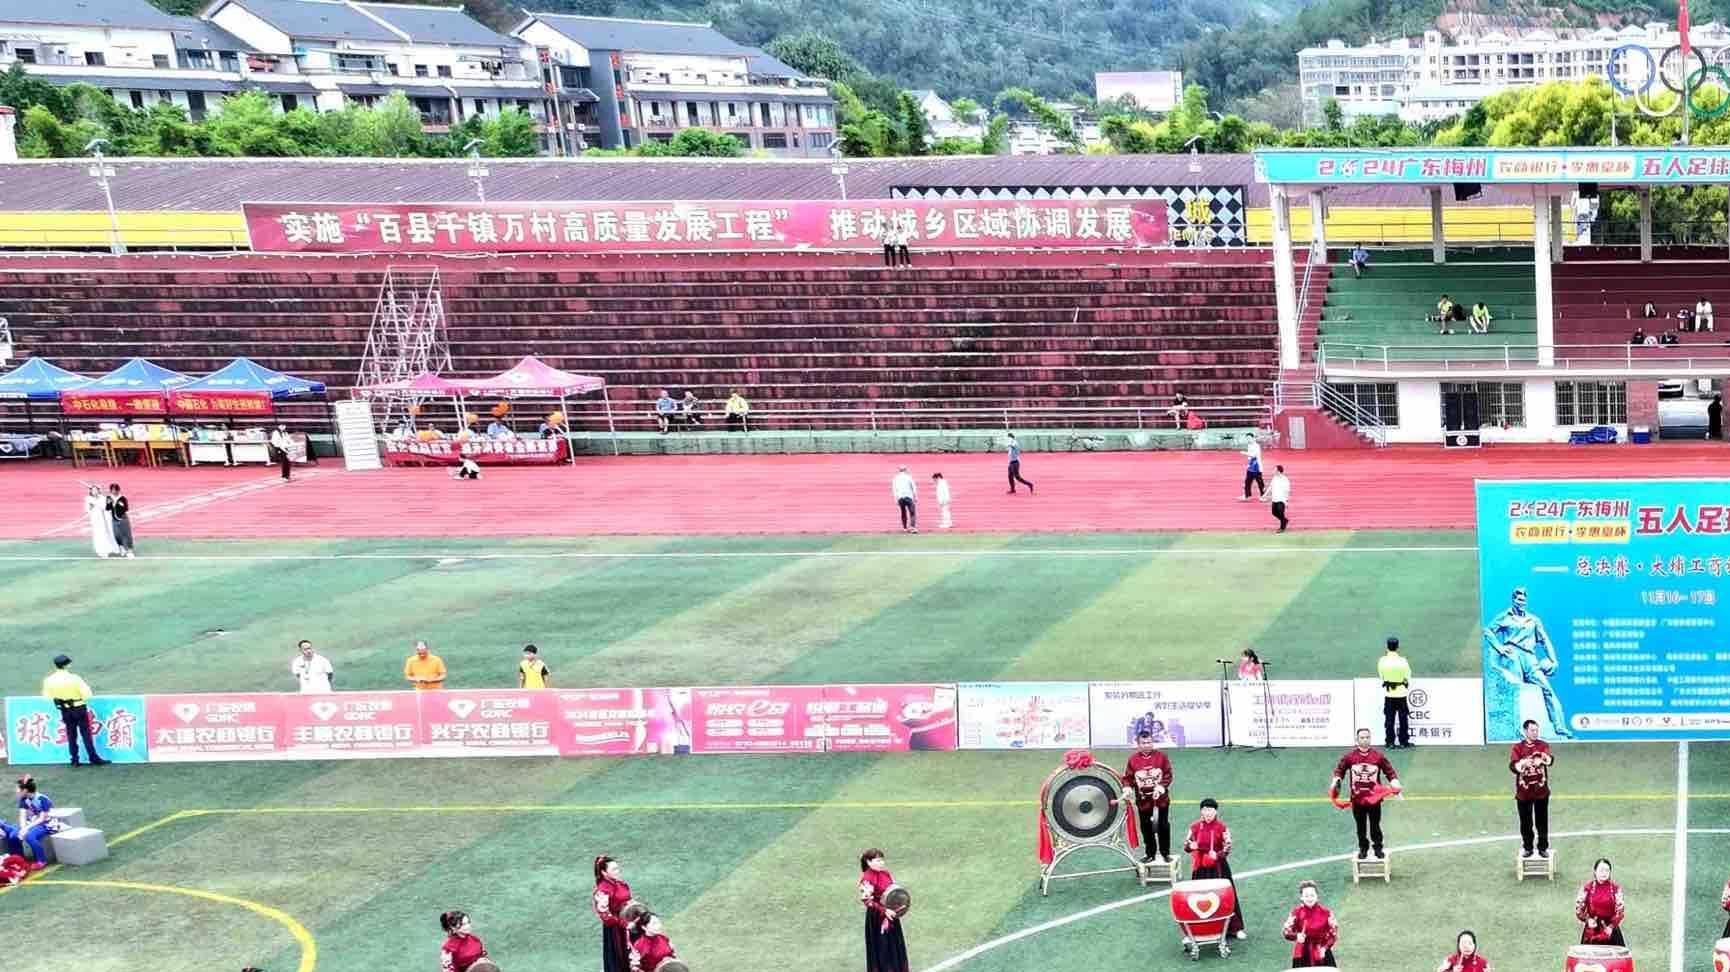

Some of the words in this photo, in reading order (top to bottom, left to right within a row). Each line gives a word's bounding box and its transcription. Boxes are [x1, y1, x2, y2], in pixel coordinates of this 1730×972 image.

[830, 206, 1133, 240] 推动城乡区域协调发展
[1408, 710, 1431, 720] CBC
